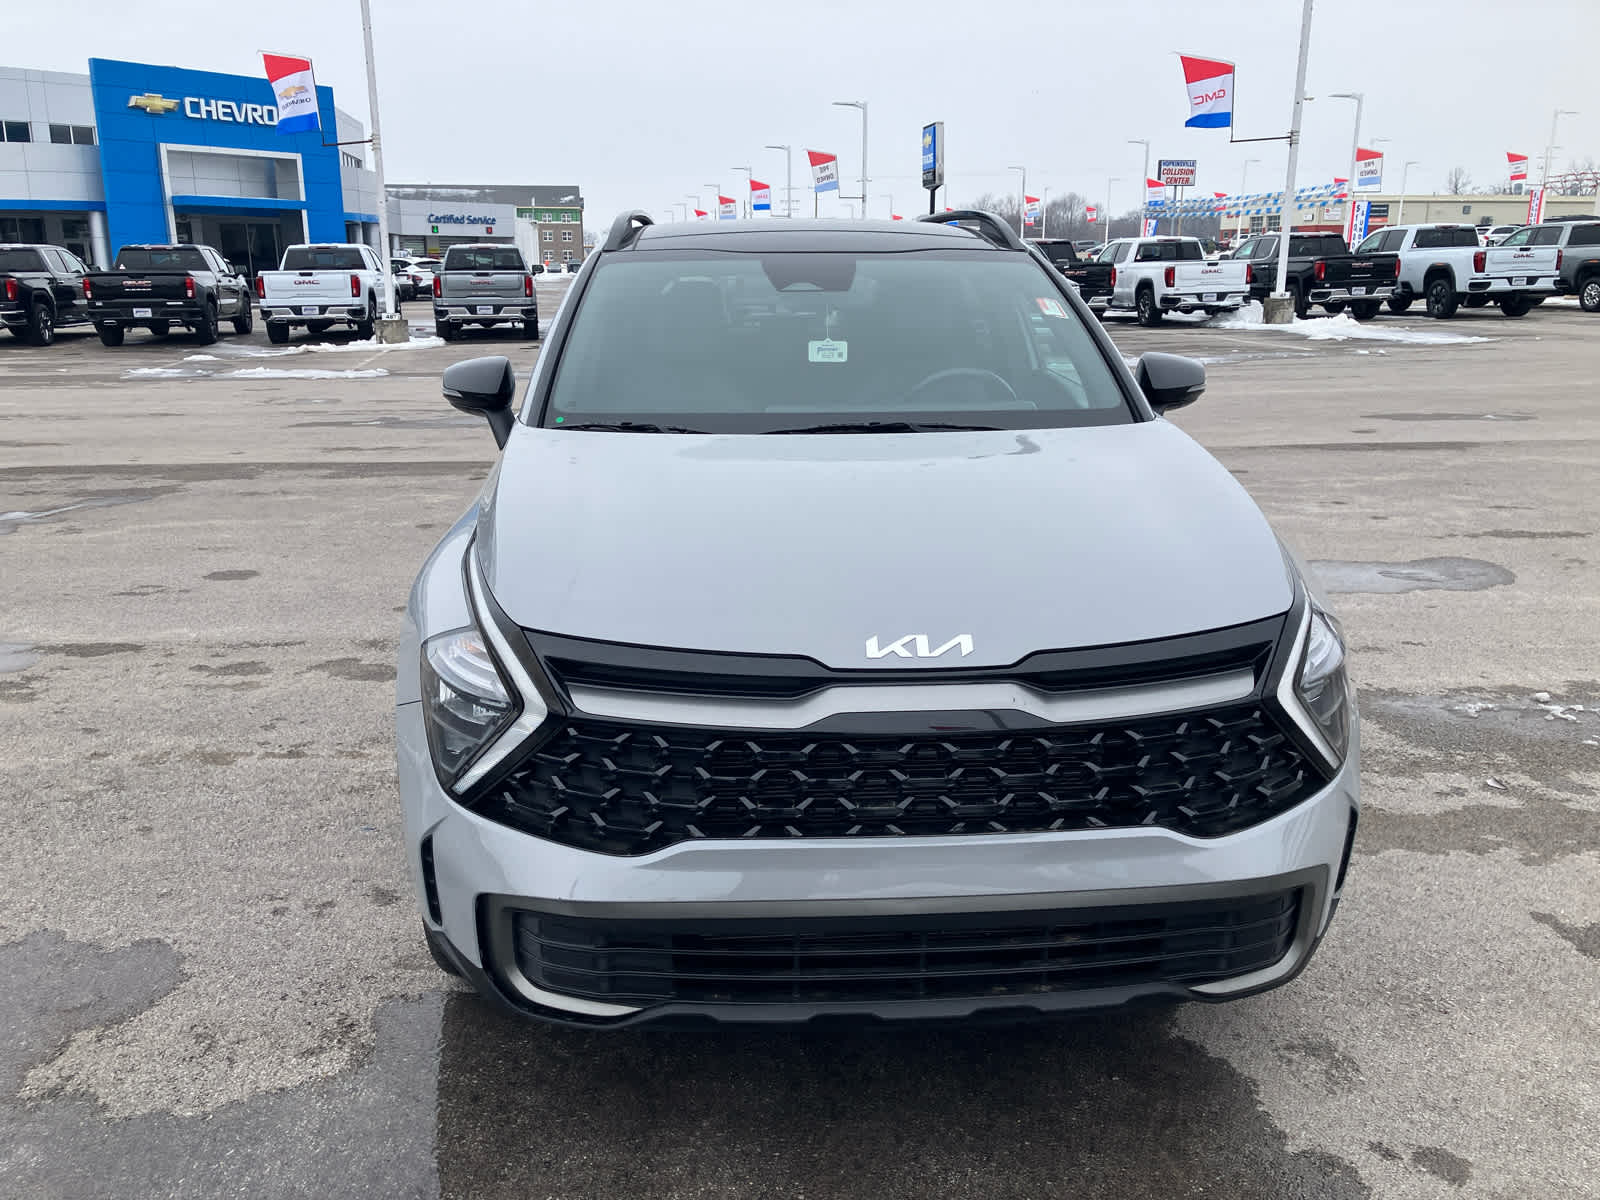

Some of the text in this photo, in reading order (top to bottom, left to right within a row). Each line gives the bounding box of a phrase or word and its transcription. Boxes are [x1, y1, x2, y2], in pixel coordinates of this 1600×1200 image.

[1162, 167, 1194, 176] COLLISION
[1165, 177, 1190, 185] CENTER
[428, 213, 496, 225] Certified Service
[865, 634, 975, 658] KIA
